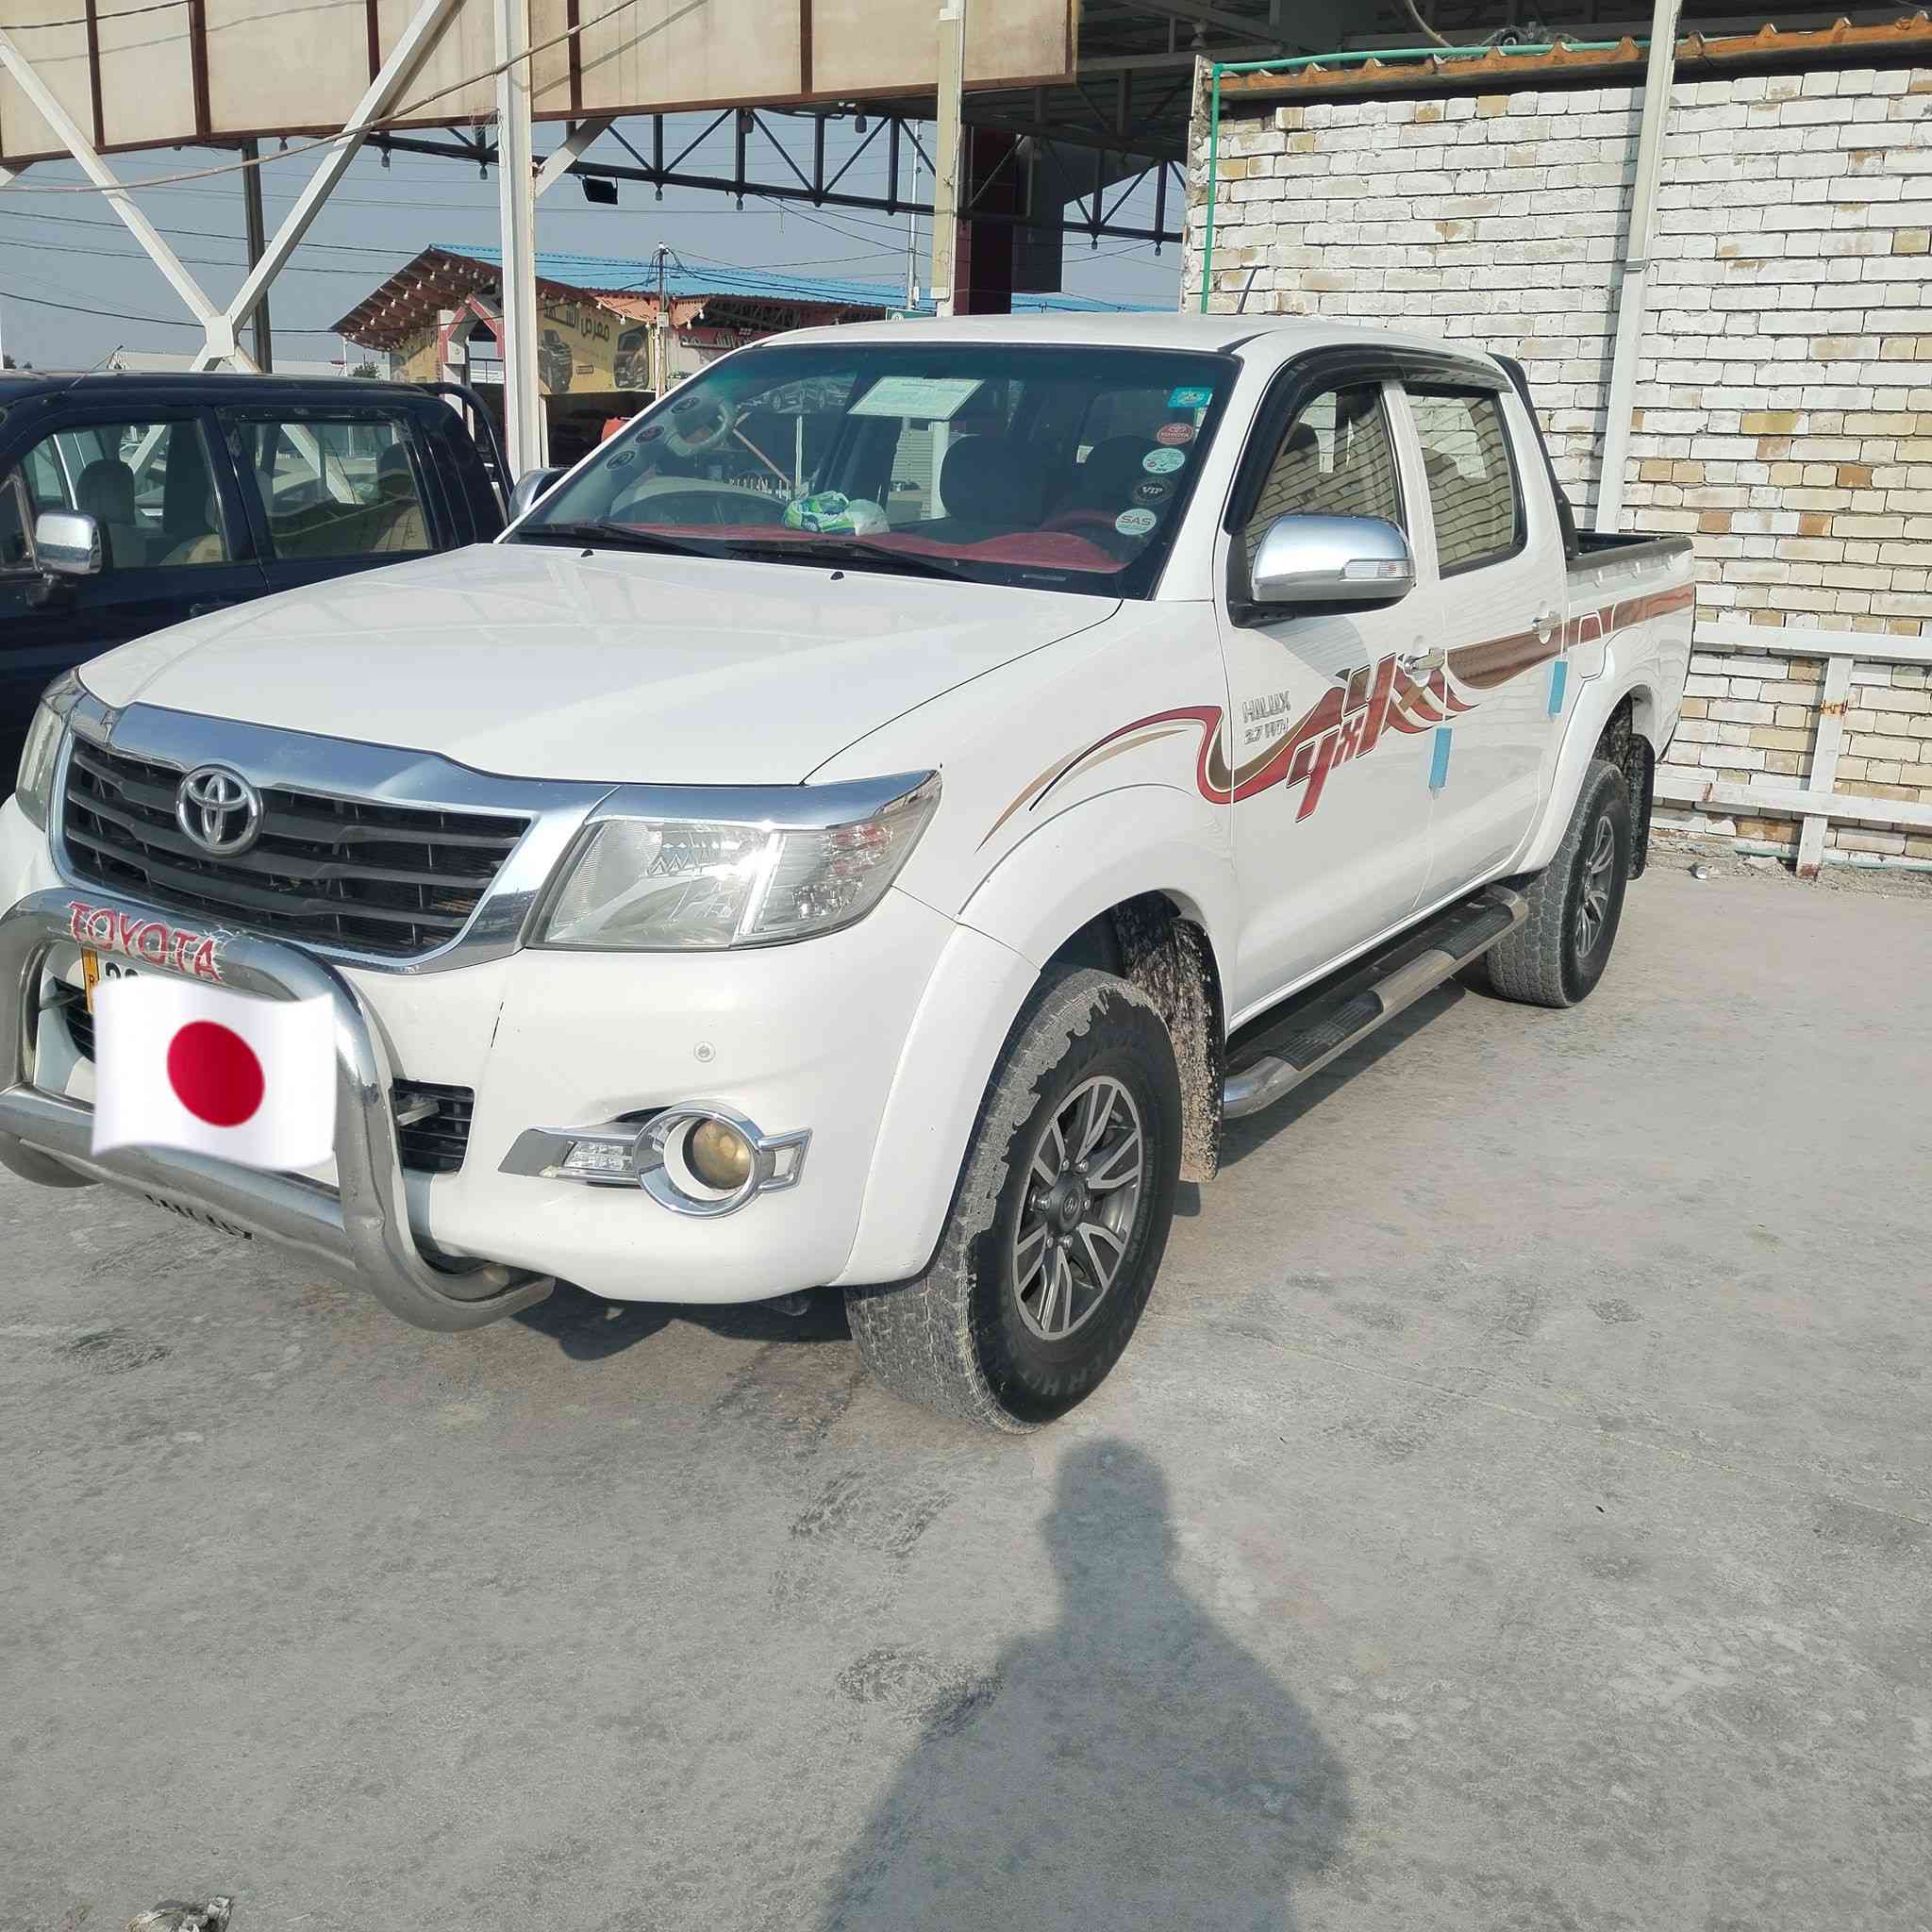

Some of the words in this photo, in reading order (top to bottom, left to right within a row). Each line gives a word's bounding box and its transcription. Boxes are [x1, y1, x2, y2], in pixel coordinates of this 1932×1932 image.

[1141, 486, 1163, 494] VIP
[1121, 515, 1152, 526] SAS
[1241, 690, 1291, 724] HILUX
[68, 901, 225, 983] TOYOTA
